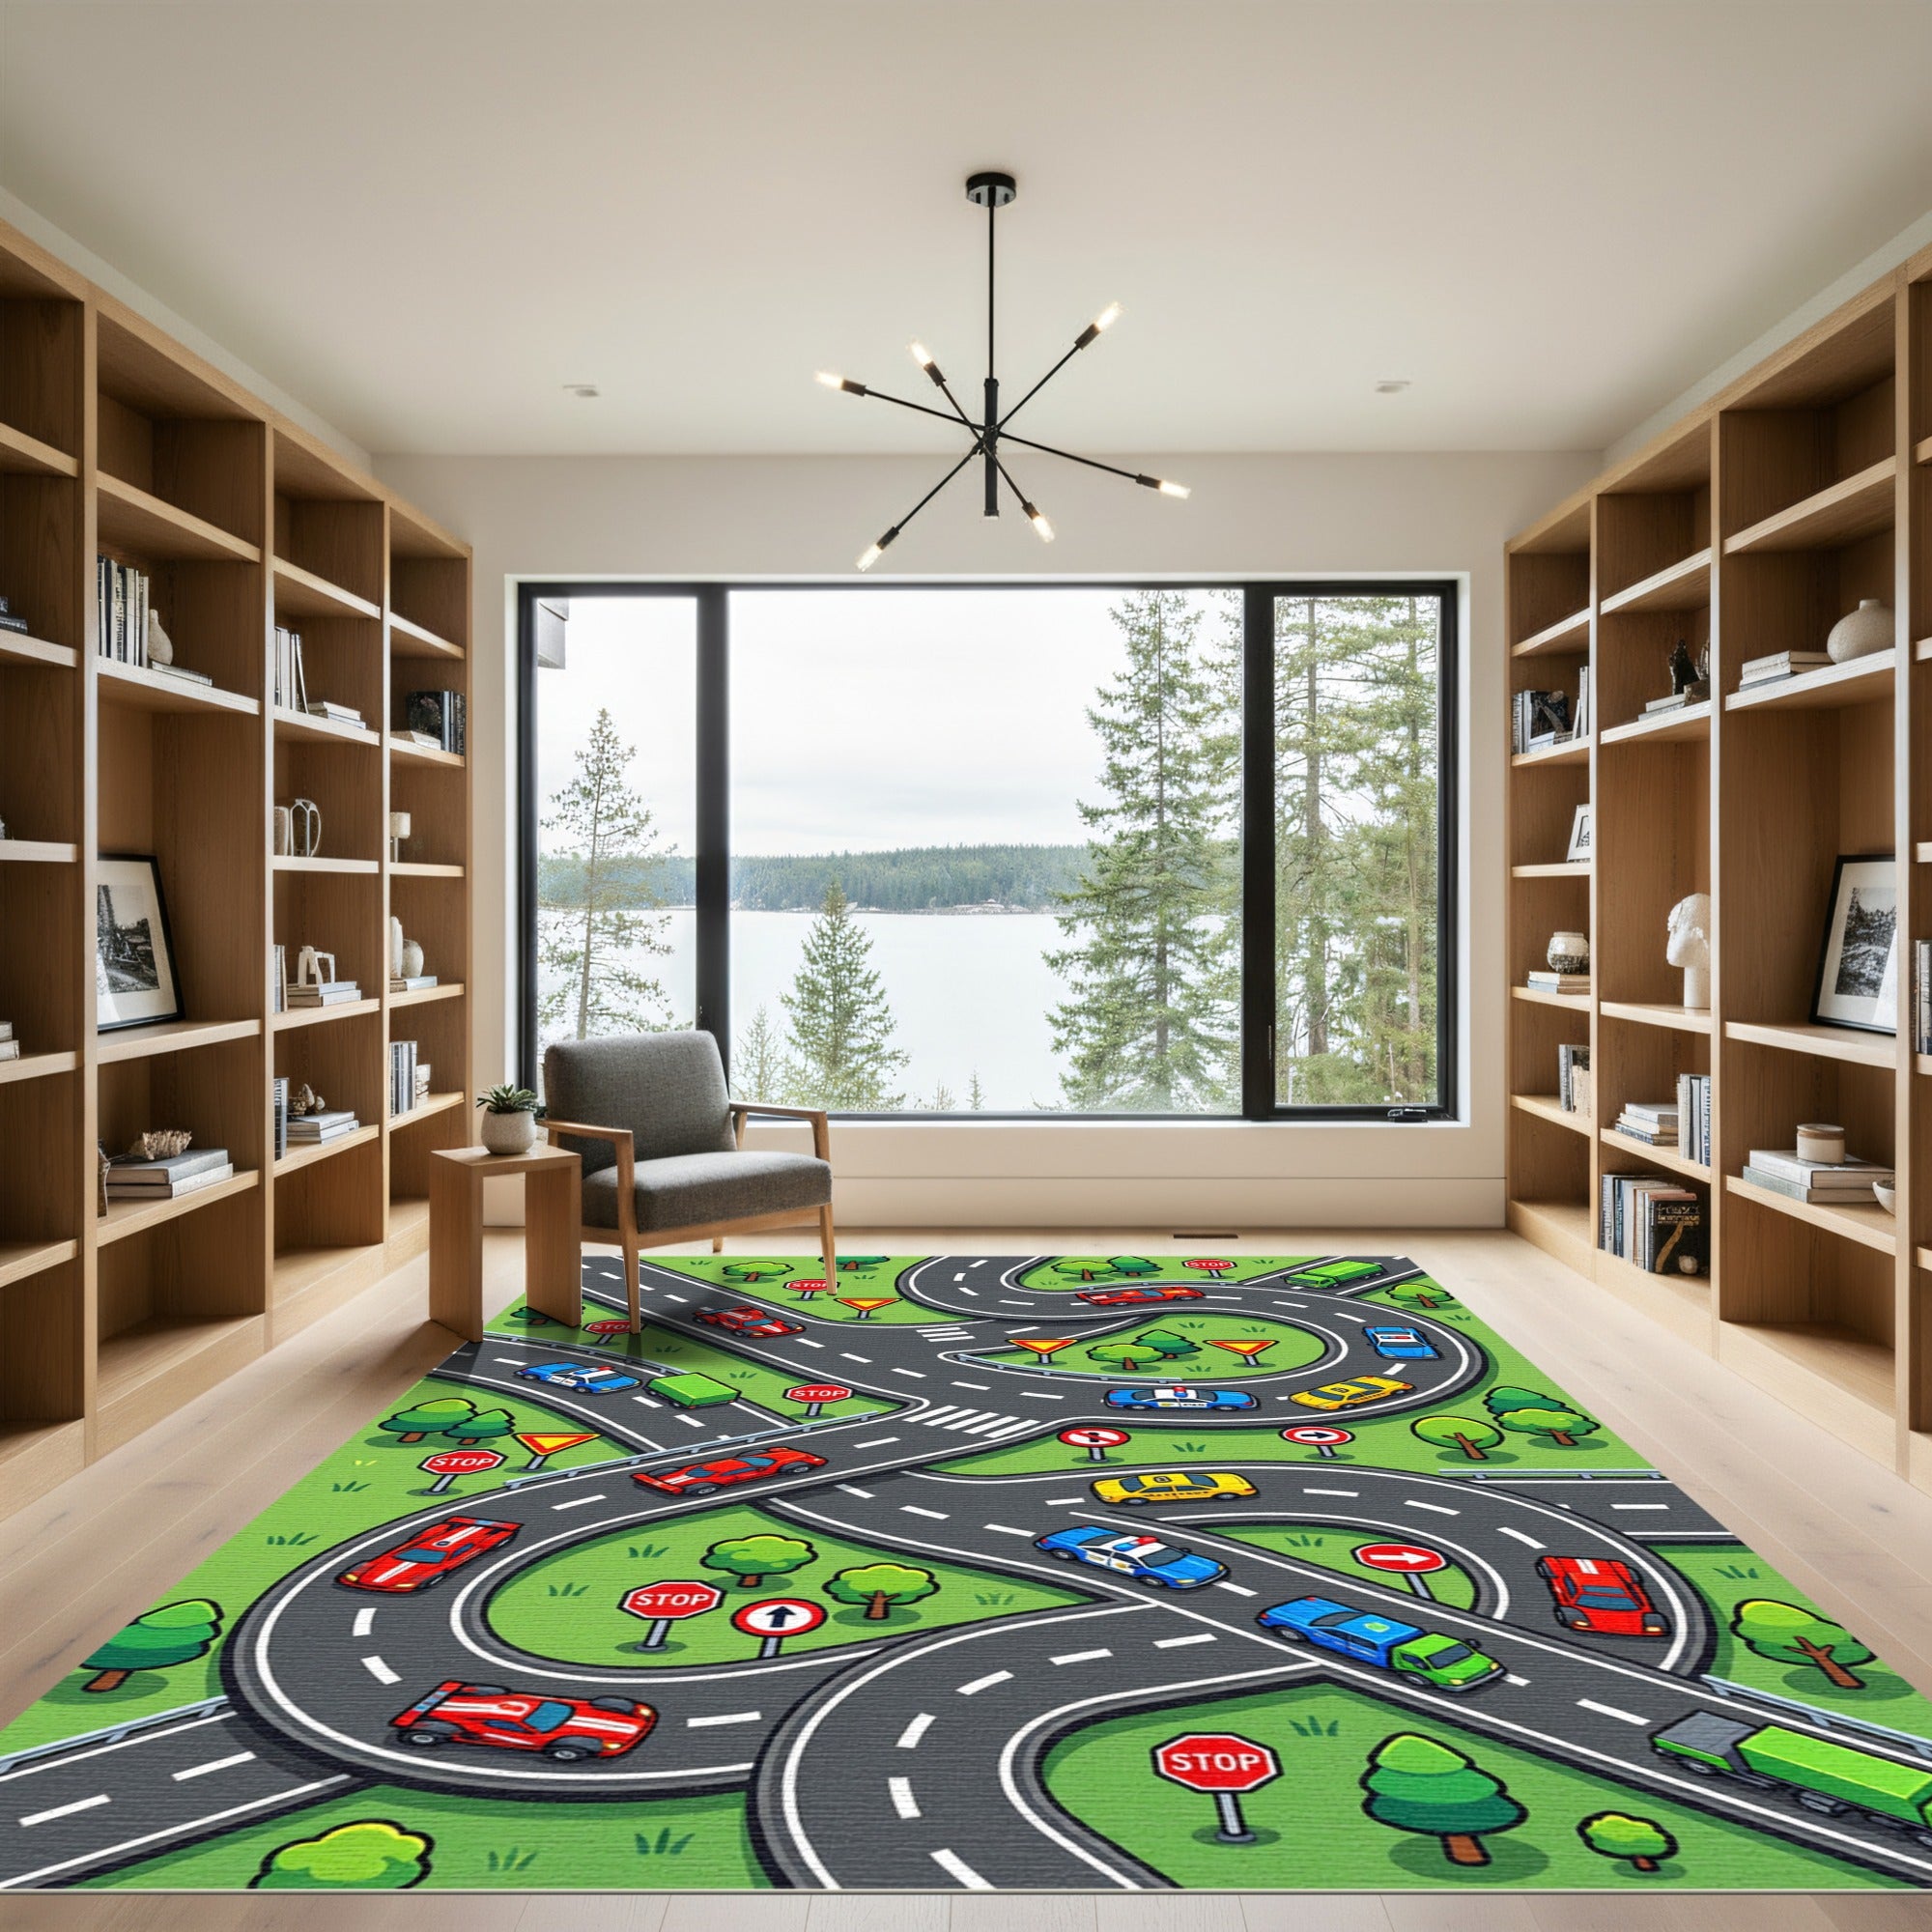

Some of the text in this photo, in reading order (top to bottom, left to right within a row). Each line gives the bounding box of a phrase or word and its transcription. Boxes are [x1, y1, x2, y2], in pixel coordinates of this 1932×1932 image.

[432, 1458, 494, 1466] STOP
[635, 1593, 710, 1606] STOP
[1170, 1752, 1261, 1772] STOP
